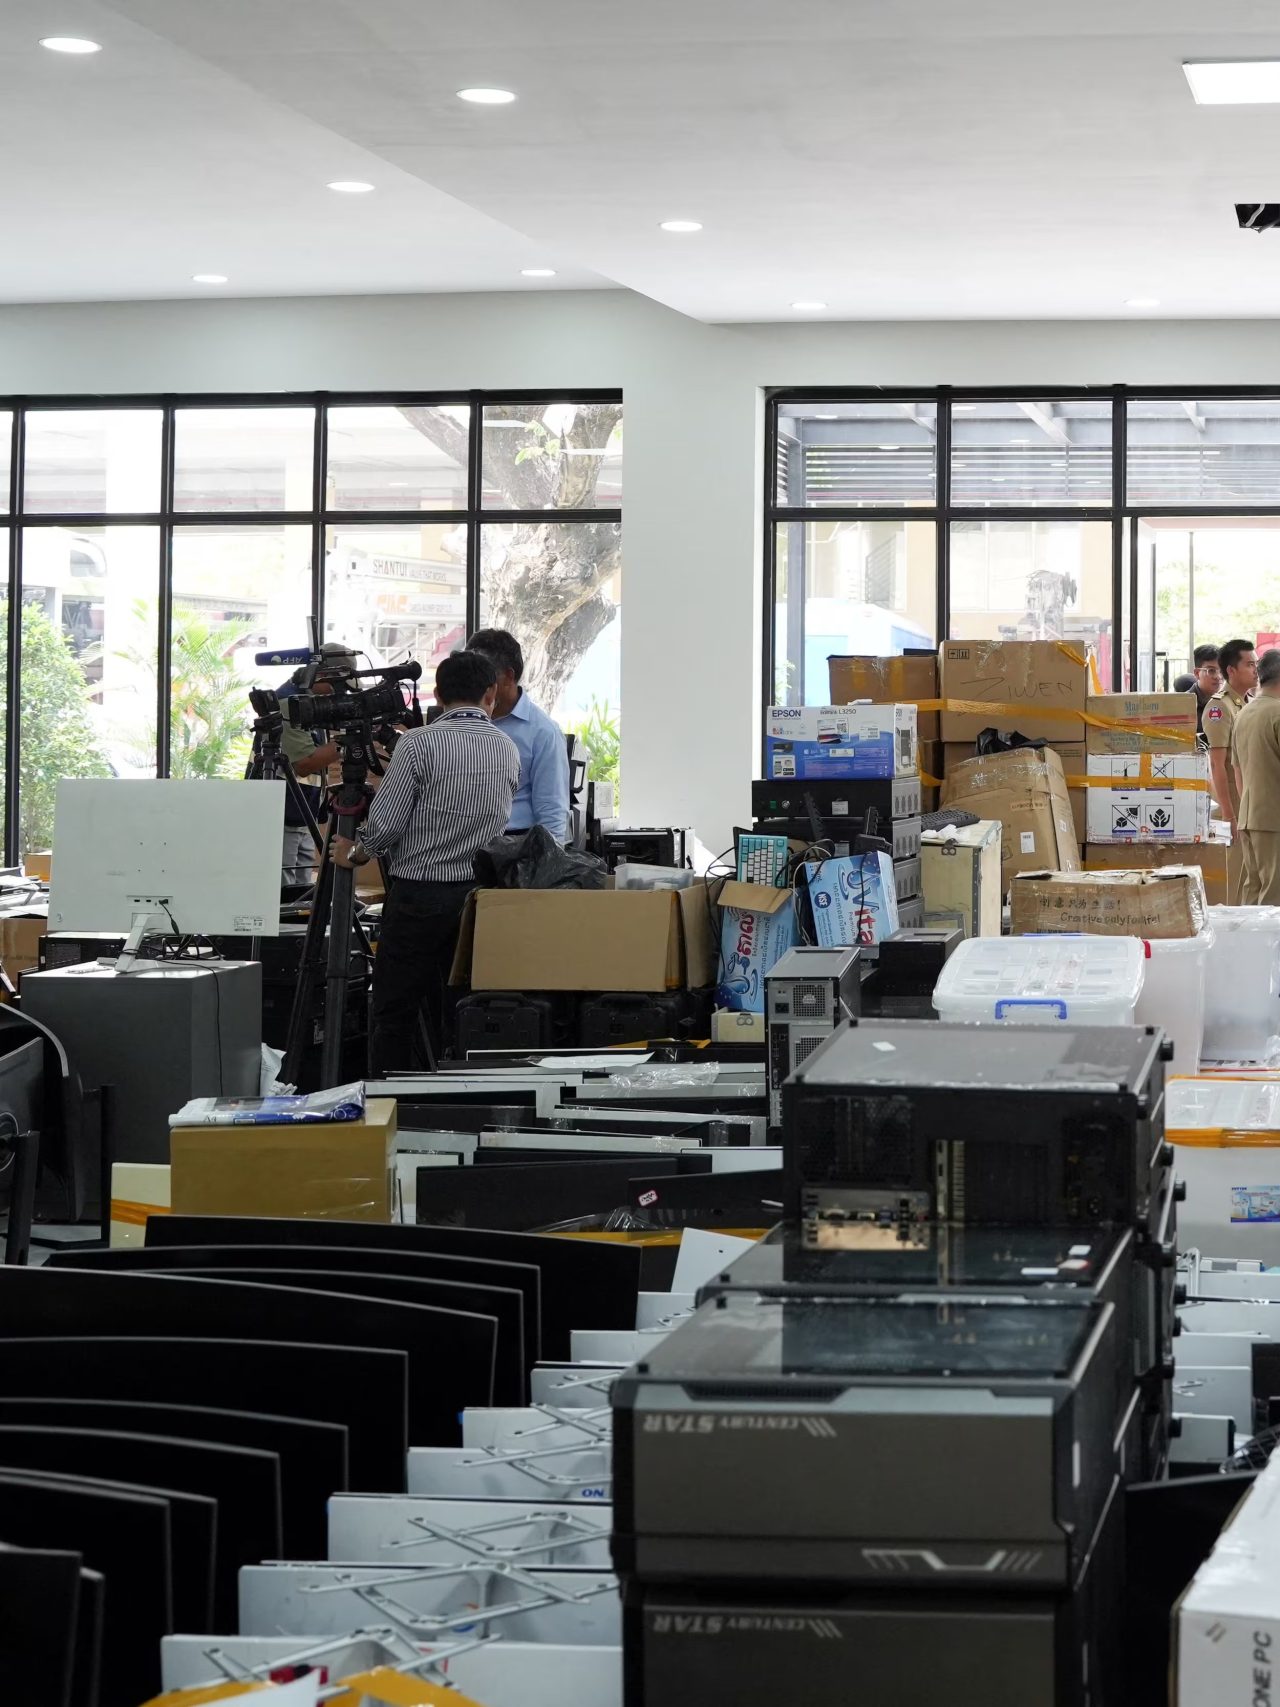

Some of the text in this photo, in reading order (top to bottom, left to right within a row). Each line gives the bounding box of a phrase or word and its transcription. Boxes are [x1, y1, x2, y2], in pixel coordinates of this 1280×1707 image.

[373, 559, 407, 577] SHANTUI
[282, 656, 304, 664] AFP
[772, 709, 802, 718] EPSON
[852, 887, 880, 945] Vita
[1060, 911, 1102, 924] Creative
[643, 1414, 801, 1434] CENTURY STAR
[652, 1615, 806, 1634] CENTURY STAR
[1253, 1631, 1273, 1665] PC
